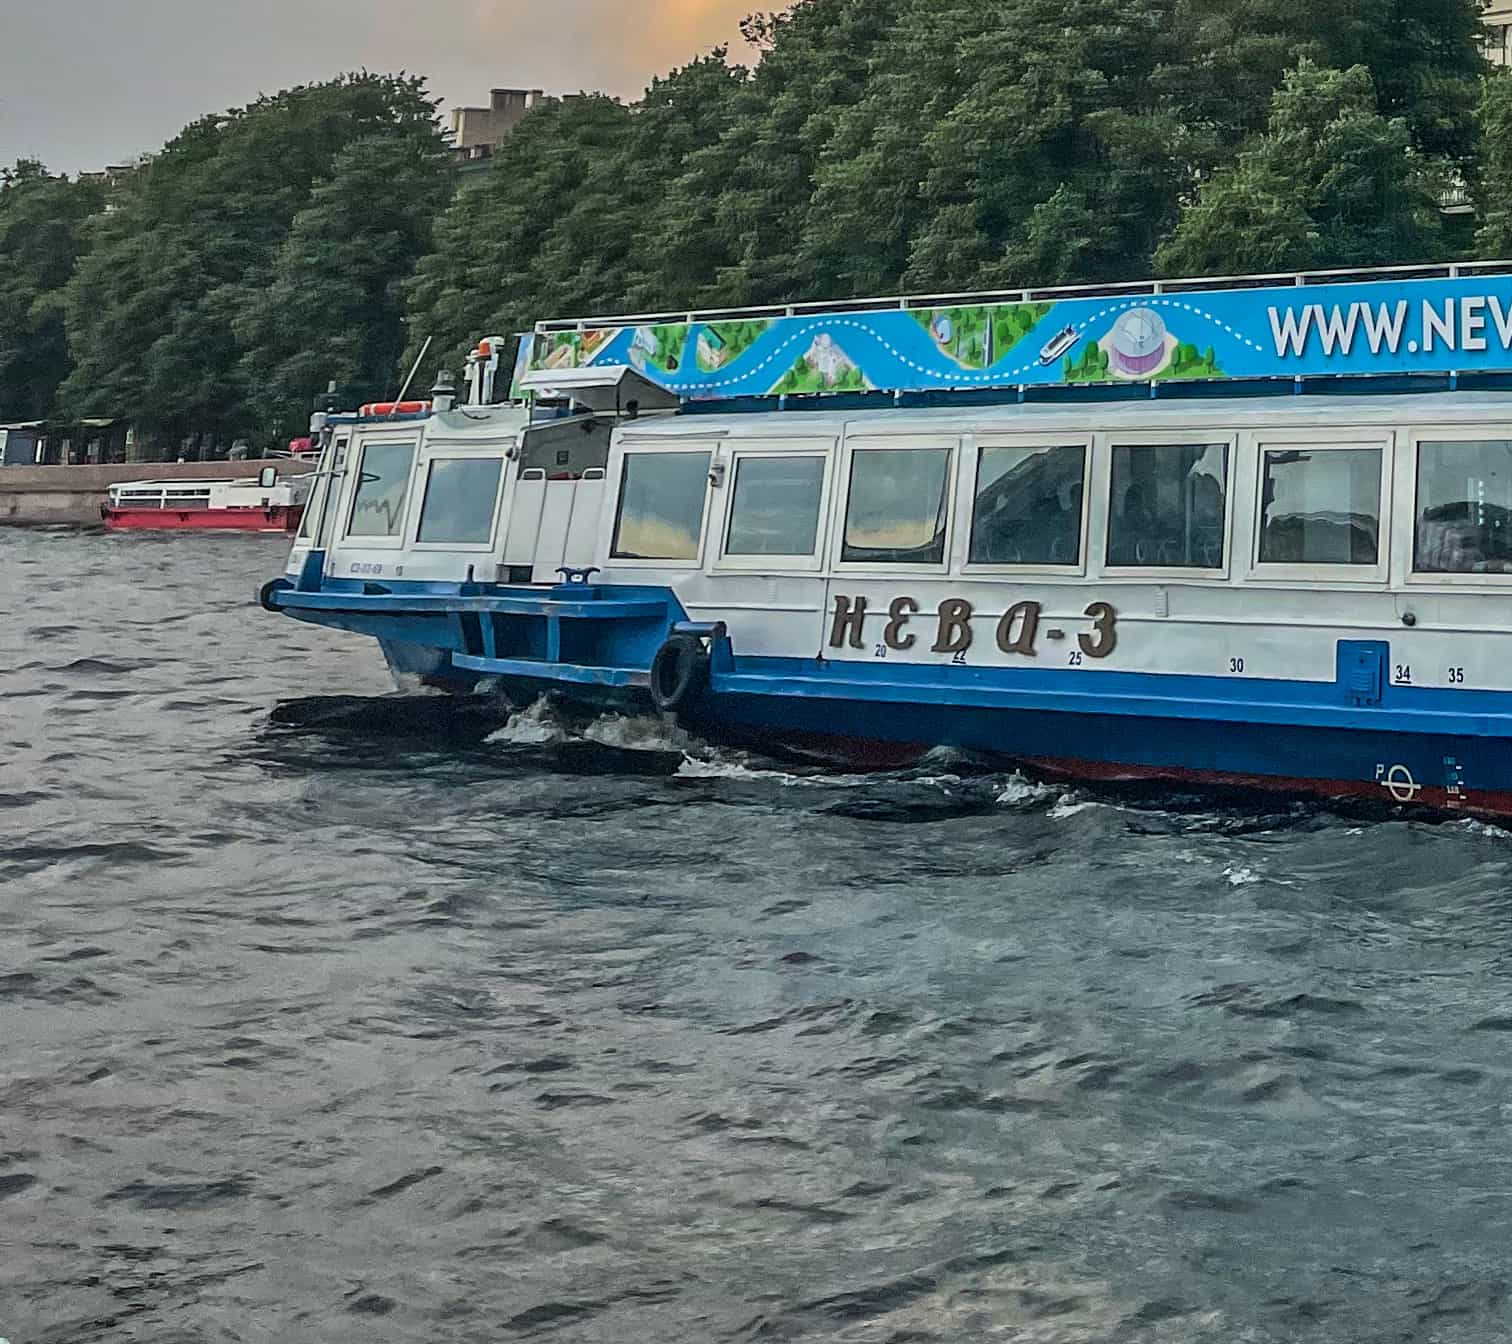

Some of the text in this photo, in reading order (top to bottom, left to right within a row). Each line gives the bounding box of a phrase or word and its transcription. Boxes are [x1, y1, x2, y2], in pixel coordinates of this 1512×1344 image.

[875, 644, 887, 657] 20
[1069, 652, 1082, 665] 25
[1230, 658, 1244, 673] 30
[1396, 665, 1411, 681] 34
[1449, 668, 1464, 683] 35
